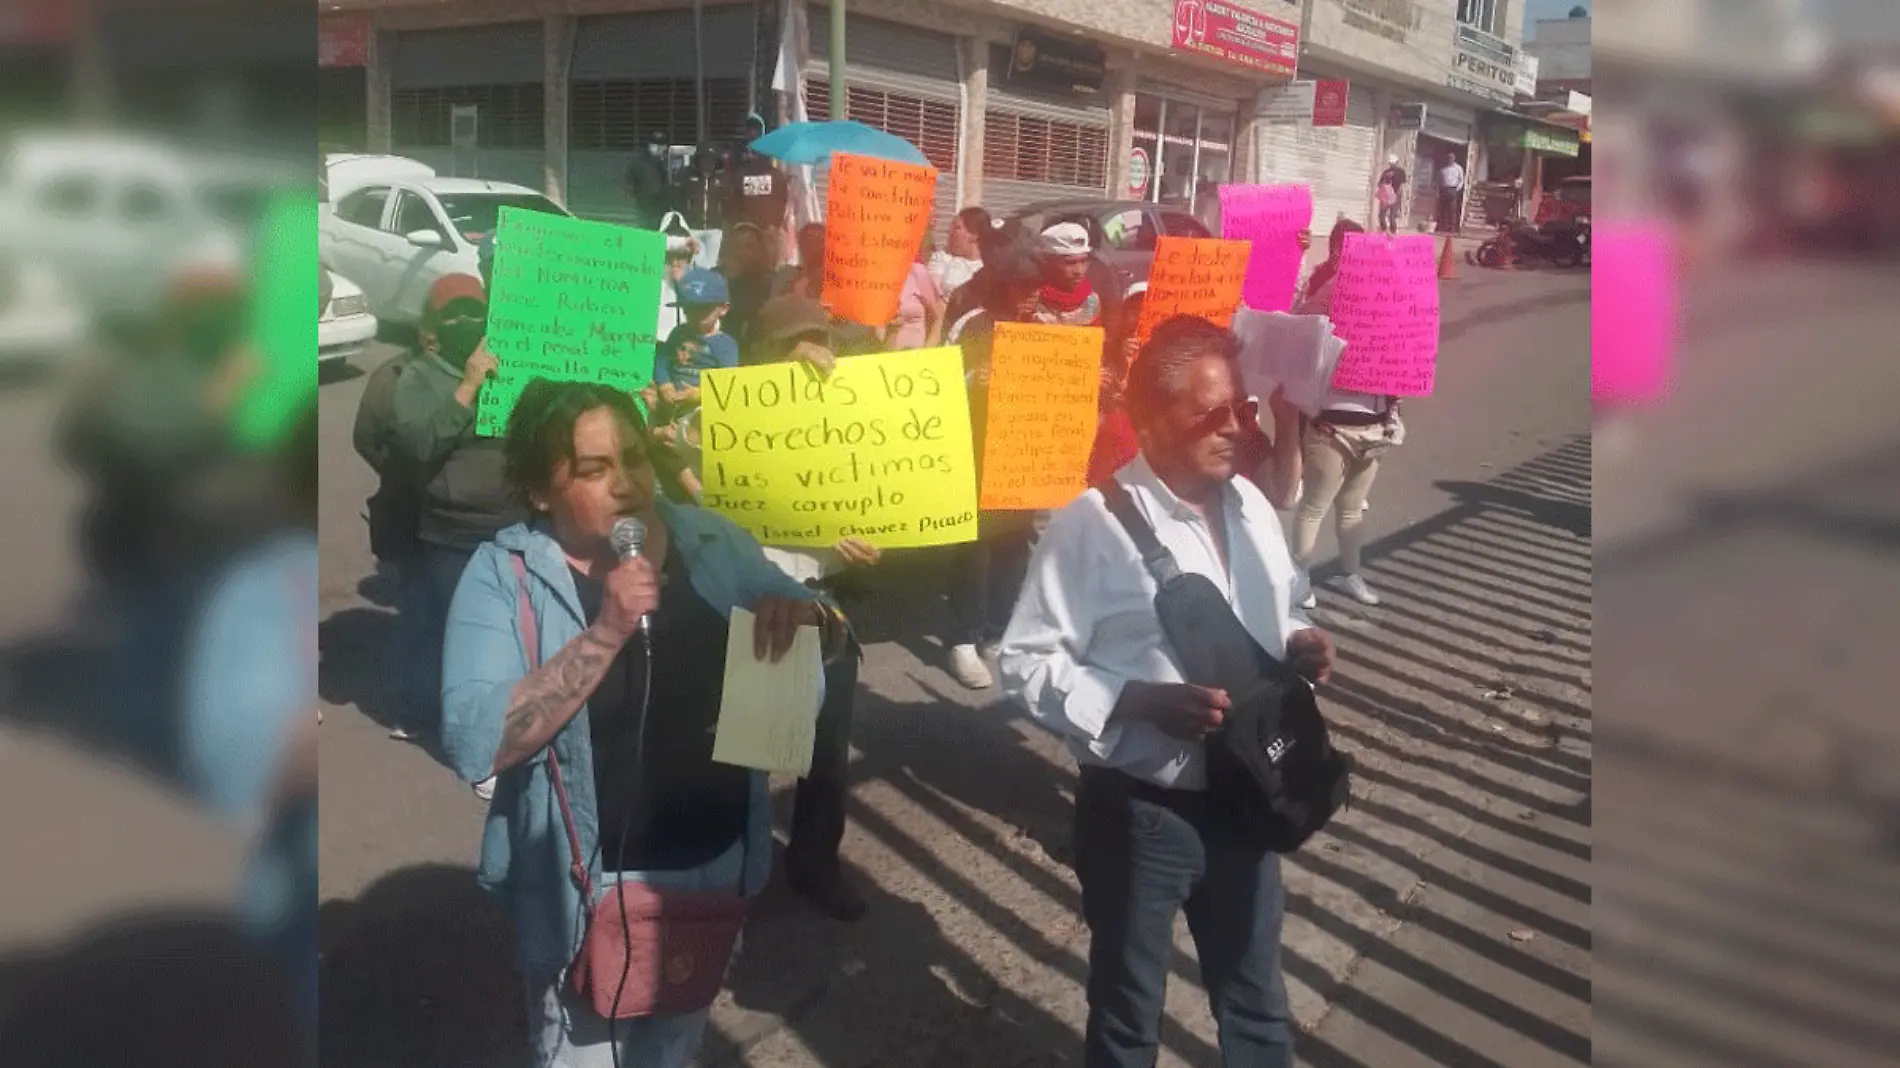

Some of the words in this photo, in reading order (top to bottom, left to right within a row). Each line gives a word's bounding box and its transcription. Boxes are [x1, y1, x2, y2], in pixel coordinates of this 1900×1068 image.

[1457, 53, 1515, 86] PERITOS
[707, 368, 858, 412] Violas
[878, 364, 941, 399] los
[709, 416, 887, 453] Derechos
[902, 408, 944, 441] de
[716, 462, 769, 489] las
[796, 452, 953, 489] victimas
[792, 486, 904, 516] corrupto
[762, 525, 821, 539] Israel
